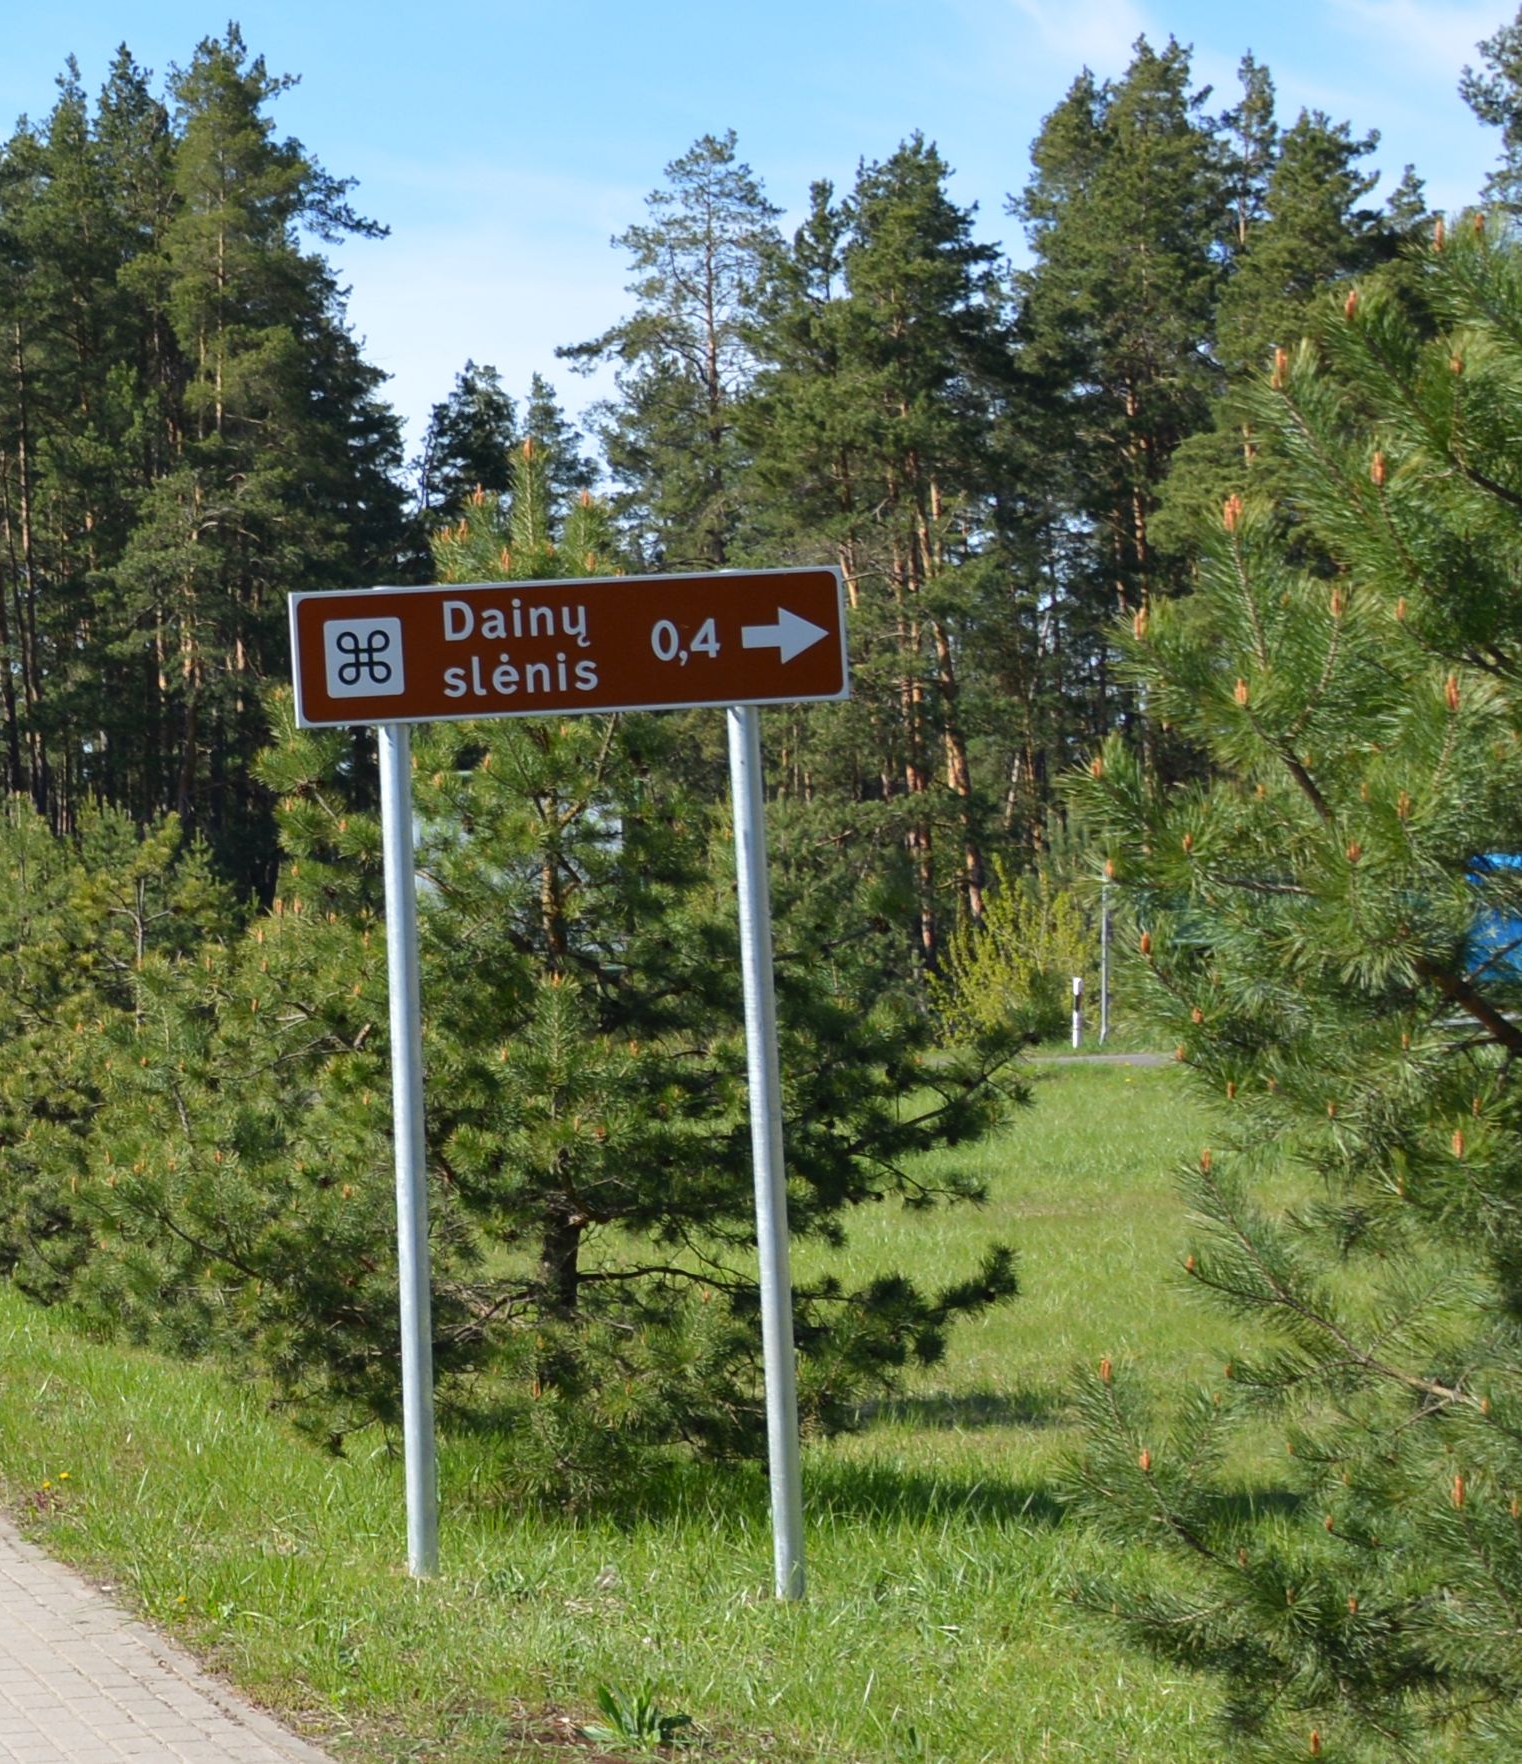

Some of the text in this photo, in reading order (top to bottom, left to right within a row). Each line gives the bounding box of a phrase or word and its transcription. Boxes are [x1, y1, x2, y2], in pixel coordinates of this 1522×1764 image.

[442, 598, 591, 648] Dainų
[650, 617, 721, 667] 0,4
[443, 652, 599, 698] slėnis
